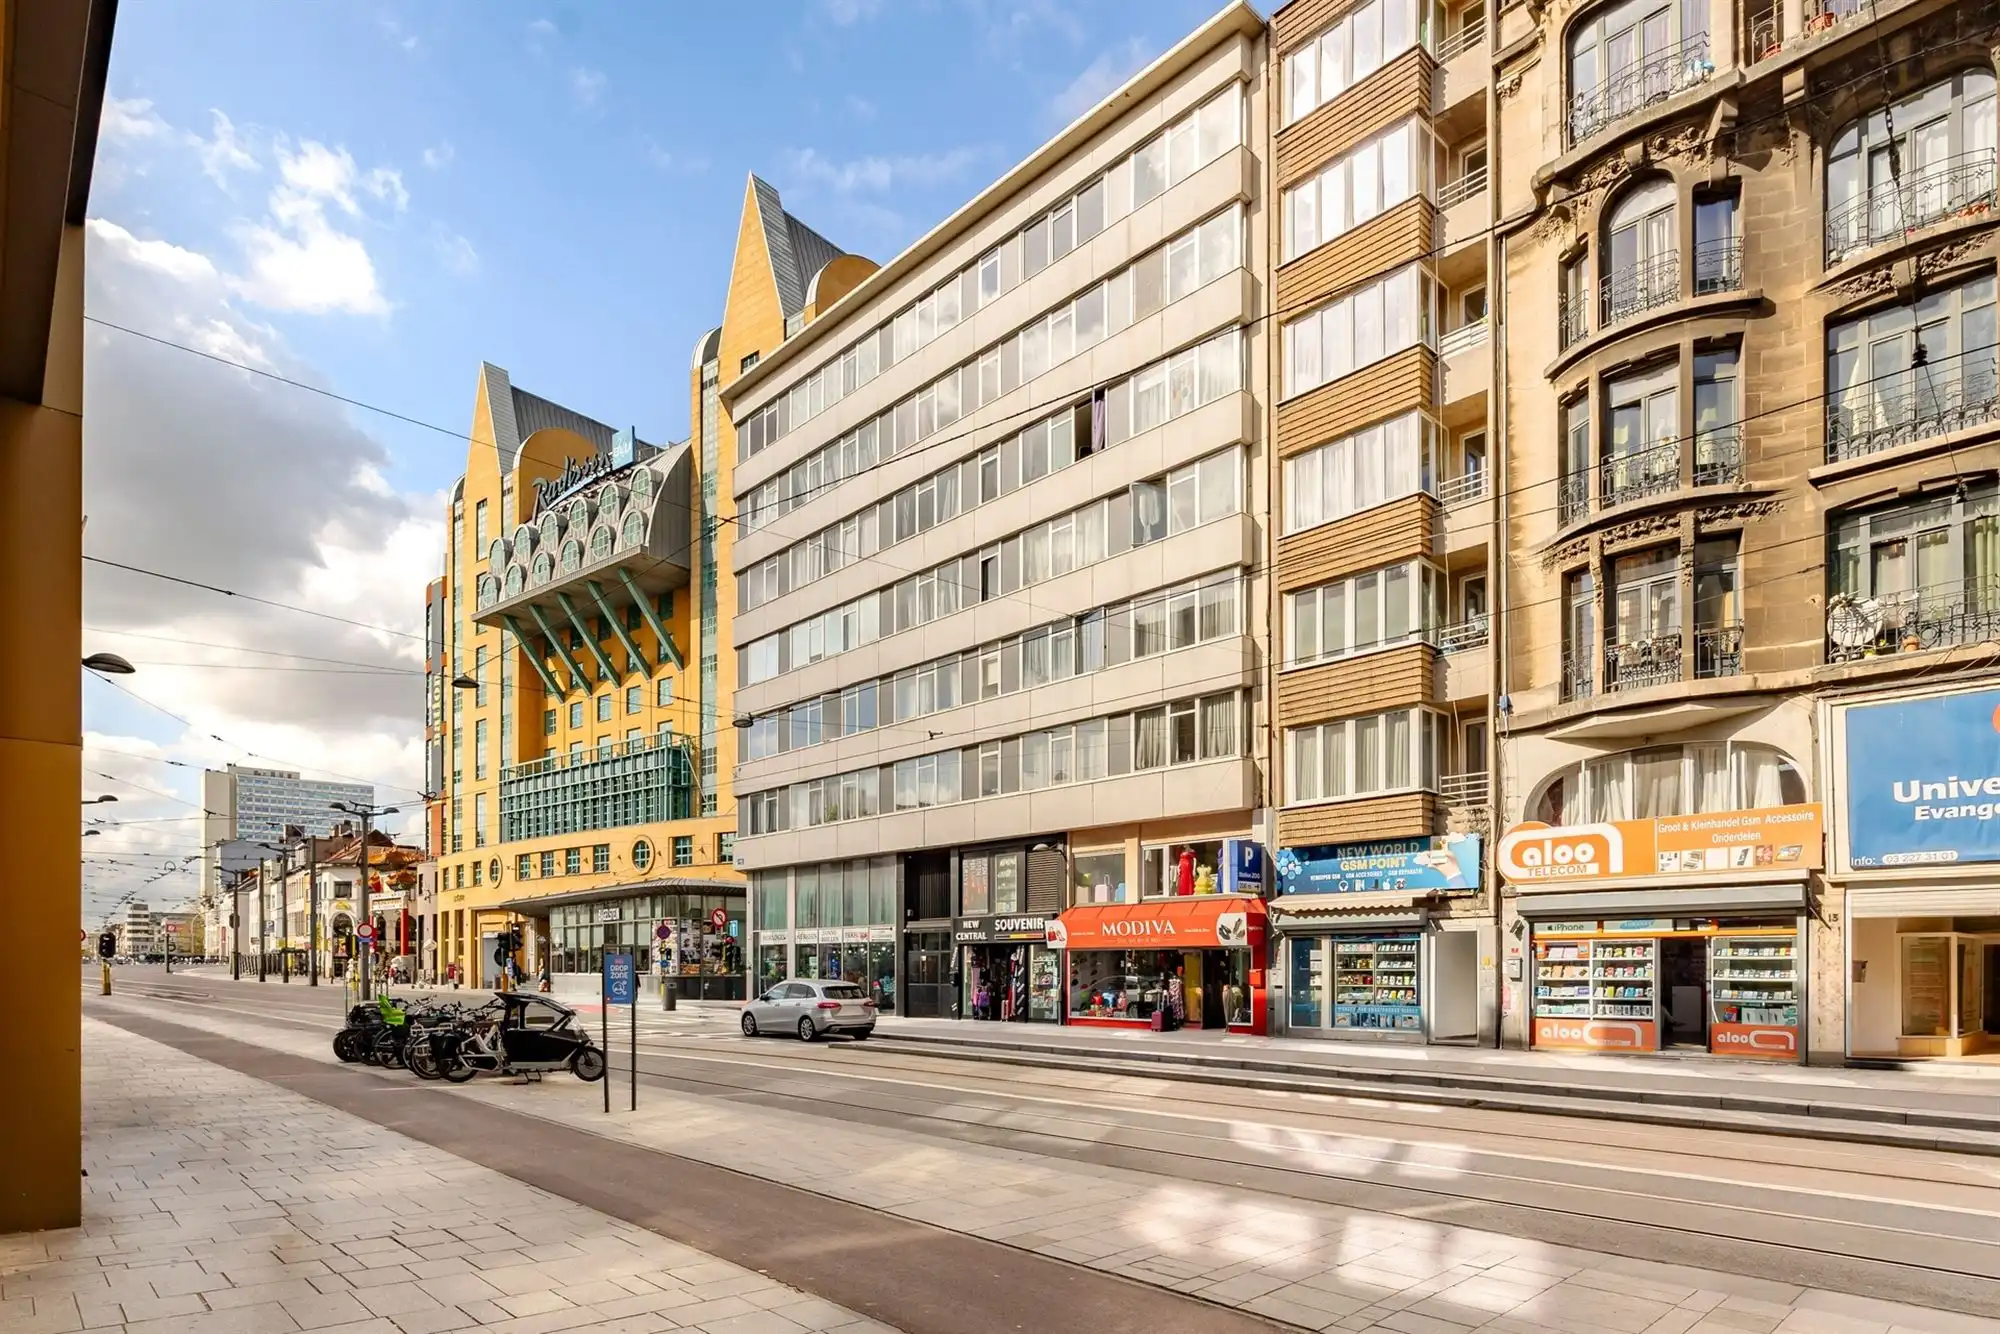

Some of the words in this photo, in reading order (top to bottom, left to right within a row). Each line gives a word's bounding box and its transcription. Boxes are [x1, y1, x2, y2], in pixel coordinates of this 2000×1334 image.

[1893, 776, 2000, 803] Unive
[1658, 823, 1681, 833] Groot
[1691, 817, 1740, 831] Kleinhandel
[1742, 816, 1760, 827] Gsm
[1765, 810, 1814, 824] Accessoire
[1712, 831, 1761, 843] Onderdelen
[1245, 846, 1253, 867] P
[1337, 846, 1367, 860] NEW
[1369, 842, 1419, 857] WORLD
[1851, 856, 1876, 866] Info:
[1527, 865, 1587, 876] TELECOM
[963, 920, 979, 929] NEW
[994, 917, 1044, 931] SOUVENIR
[1102, 919, 1176, 936] MODIVA
[1554, 923, 1584, 932] iPhone
[955, 932, 987, 940] CENTRAL
[610, 964, 629, 972] DROP
